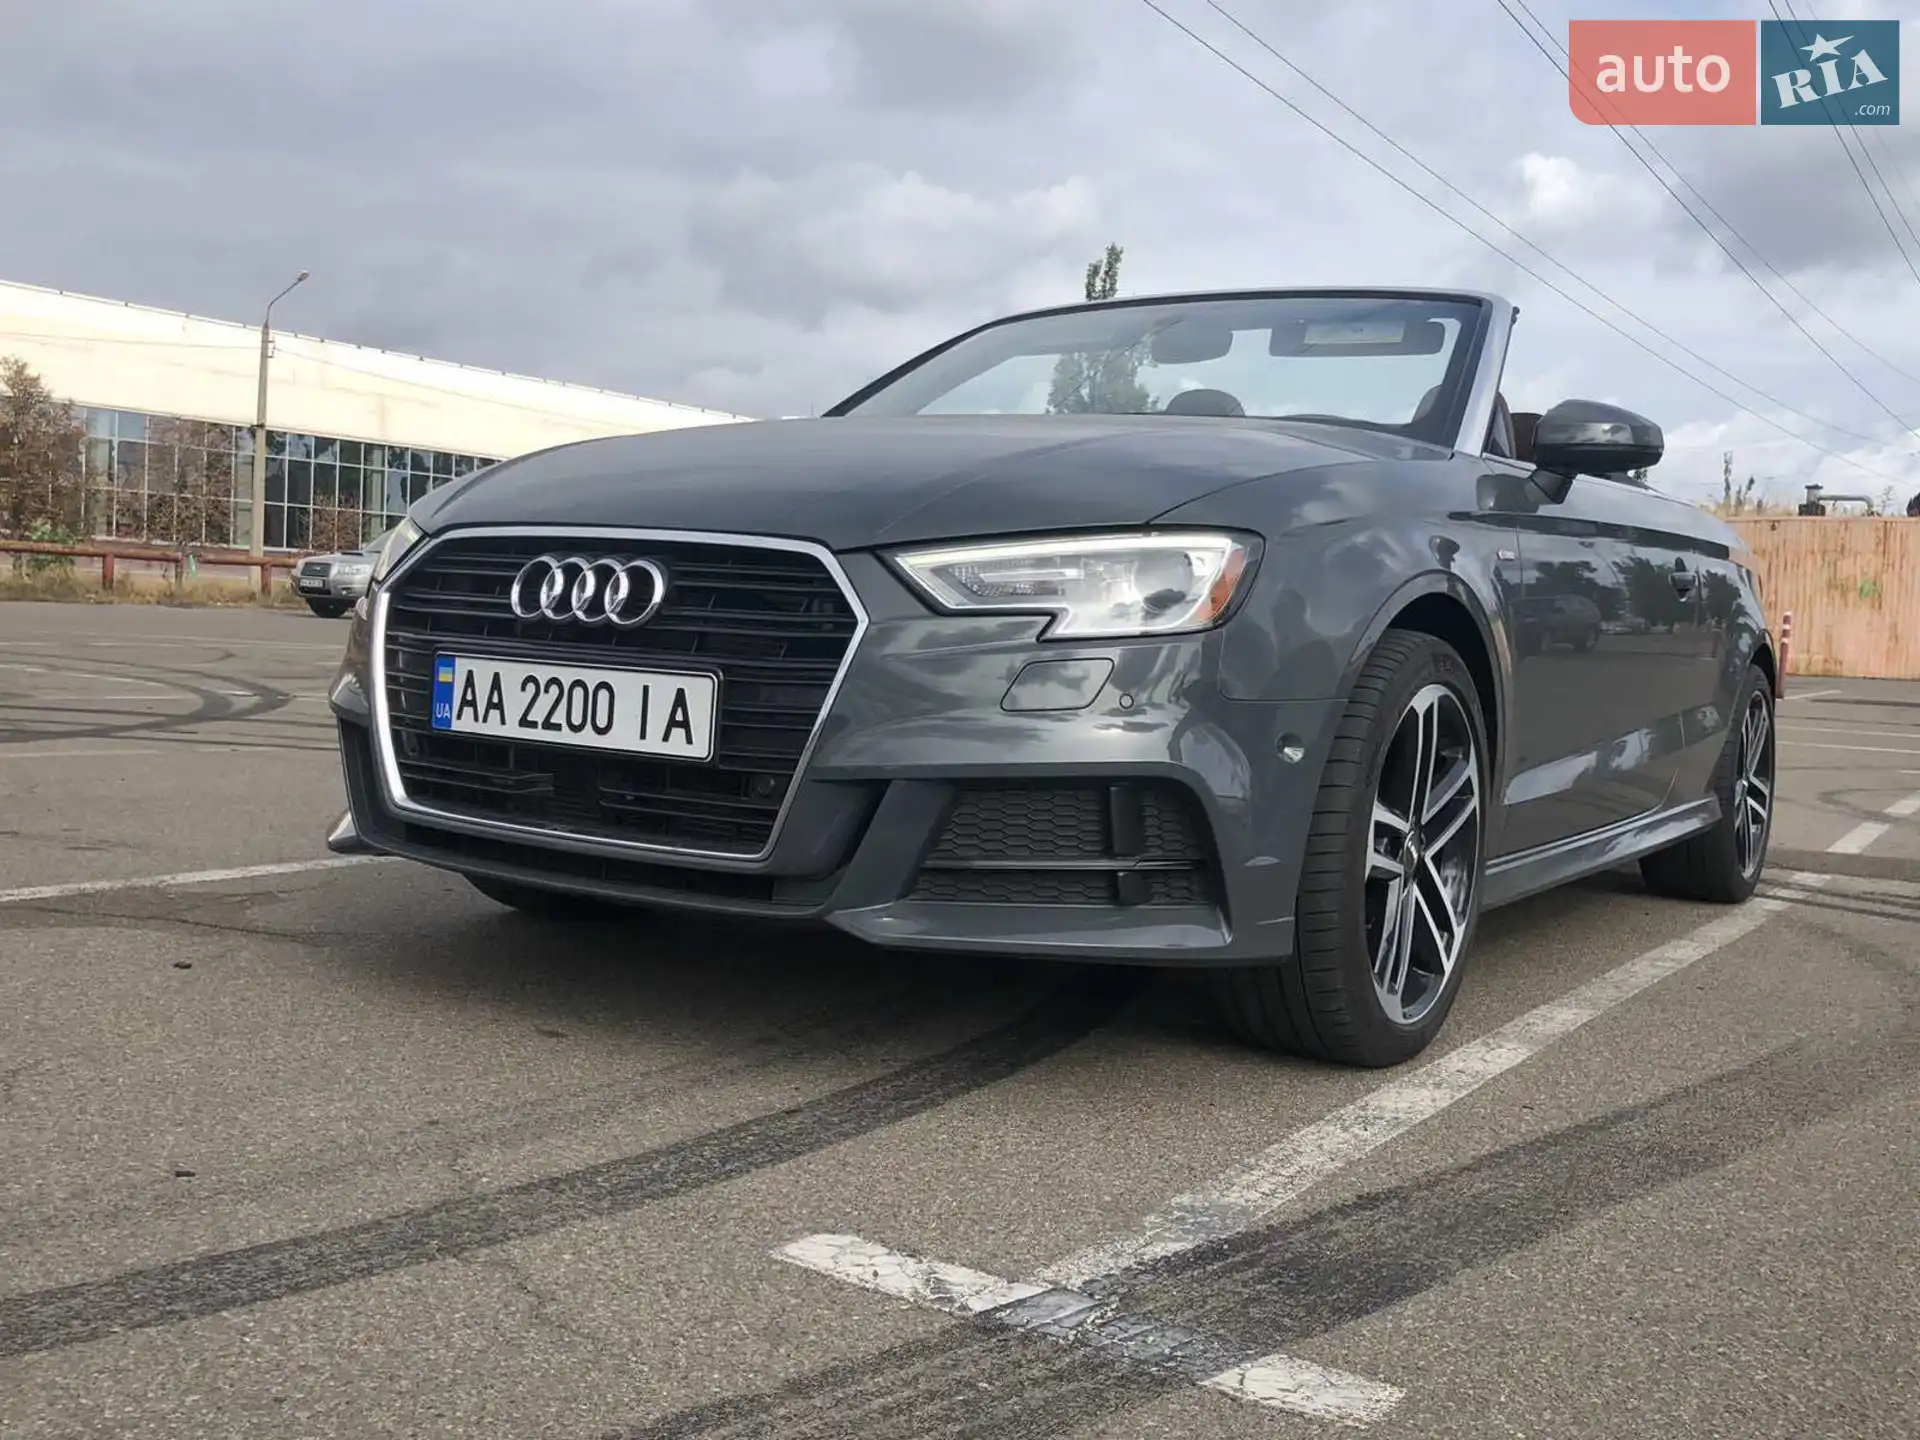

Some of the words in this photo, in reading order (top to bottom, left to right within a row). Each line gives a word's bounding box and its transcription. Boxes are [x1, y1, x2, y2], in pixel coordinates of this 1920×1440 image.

[436, 702, 451, 719] UA
[456, 669, 507, 726] AA
[518, 674, 616, 736] 2200
